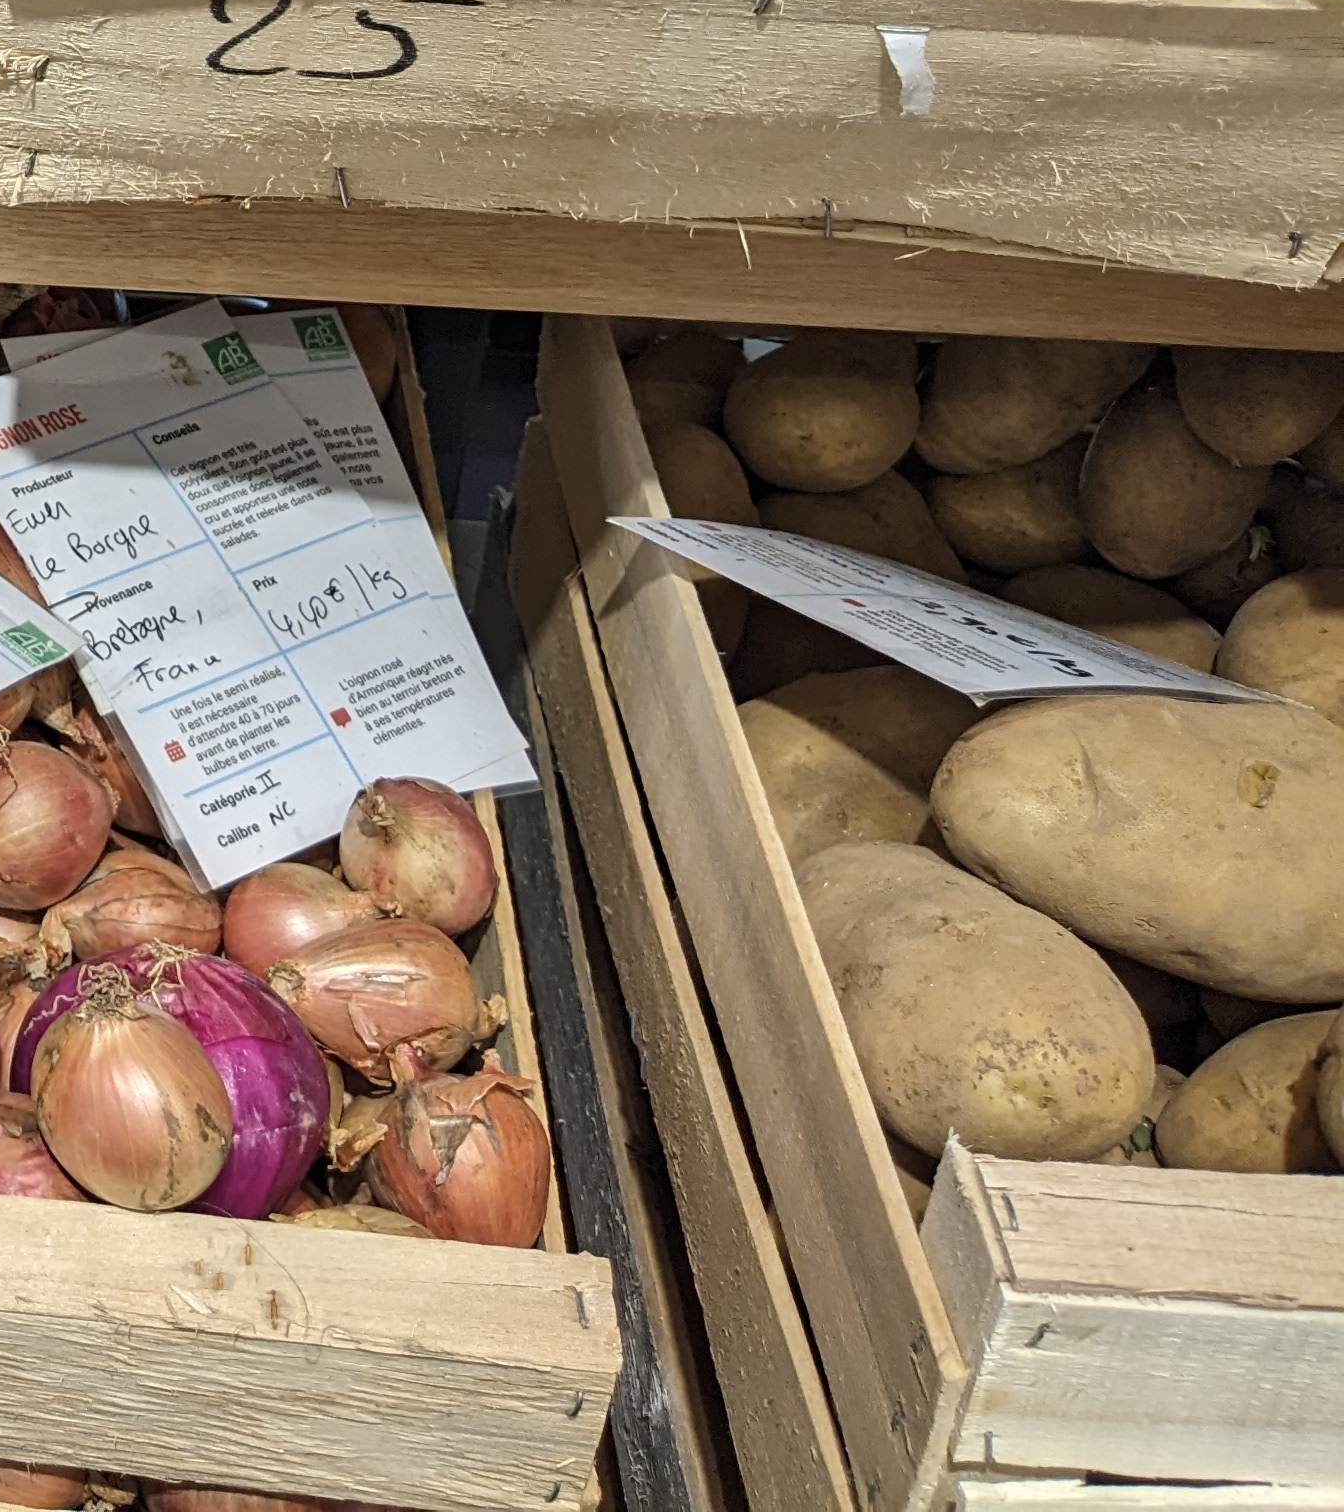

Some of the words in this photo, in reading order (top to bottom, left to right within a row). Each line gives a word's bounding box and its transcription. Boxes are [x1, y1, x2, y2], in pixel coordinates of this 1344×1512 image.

[36, 403, 88, 436] ROSE
[151, 422, 202, 446] Conseils
[11, 469, 74, 498] Producteur
[84, 580, 154, 613] Provenance
[251, 575, 279, 593] Prix
[338, 668, 382, 692] L'oignon
[380, 656, 404, 674] rosé
[347, 674, 407, 705] d'Armorique
[405, 661, 435, 680] réagit
[432, 654, 455, 668] très
[354, 702, 379, 719] bien
[378, 697, 393, 709] au
[390, 683, 422, 703] terroir
[419, 670, 455, 690] breton
[453, 664, 466, 677] et
[363, 720, 374, 732] à
[372, 714, 393, 729] ses
[390, 687, 456, 721] températures
[372, 717, 426, 746] clémentes.
[199, 784, 258, 816] Catégorie
[216, 822, 261, 848] Calibre
